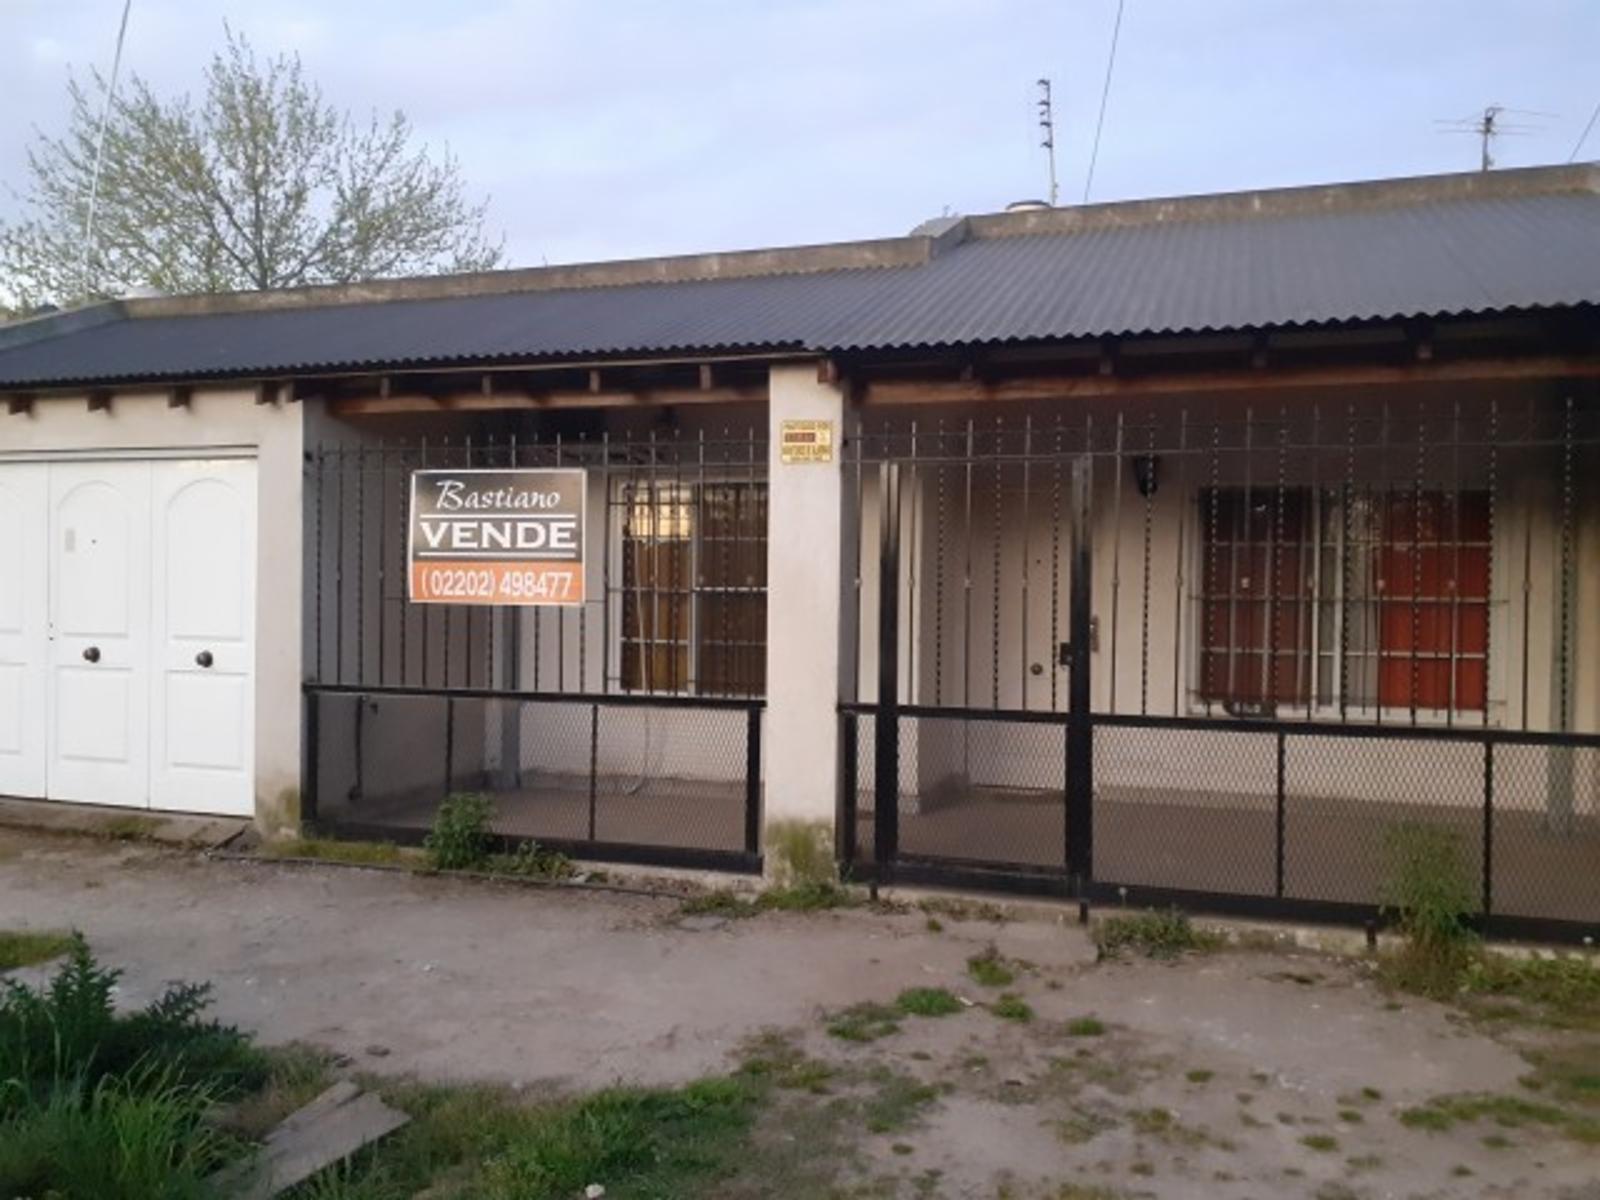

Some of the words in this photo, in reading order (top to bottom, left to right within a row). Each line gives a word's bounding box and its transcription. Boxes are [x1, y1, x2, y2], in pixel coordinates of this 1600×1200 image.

[436, 479, 561, 510] Bastiano
[419, 521, 577, 549] VENDE
[499, 570, 574, 598] 498477
